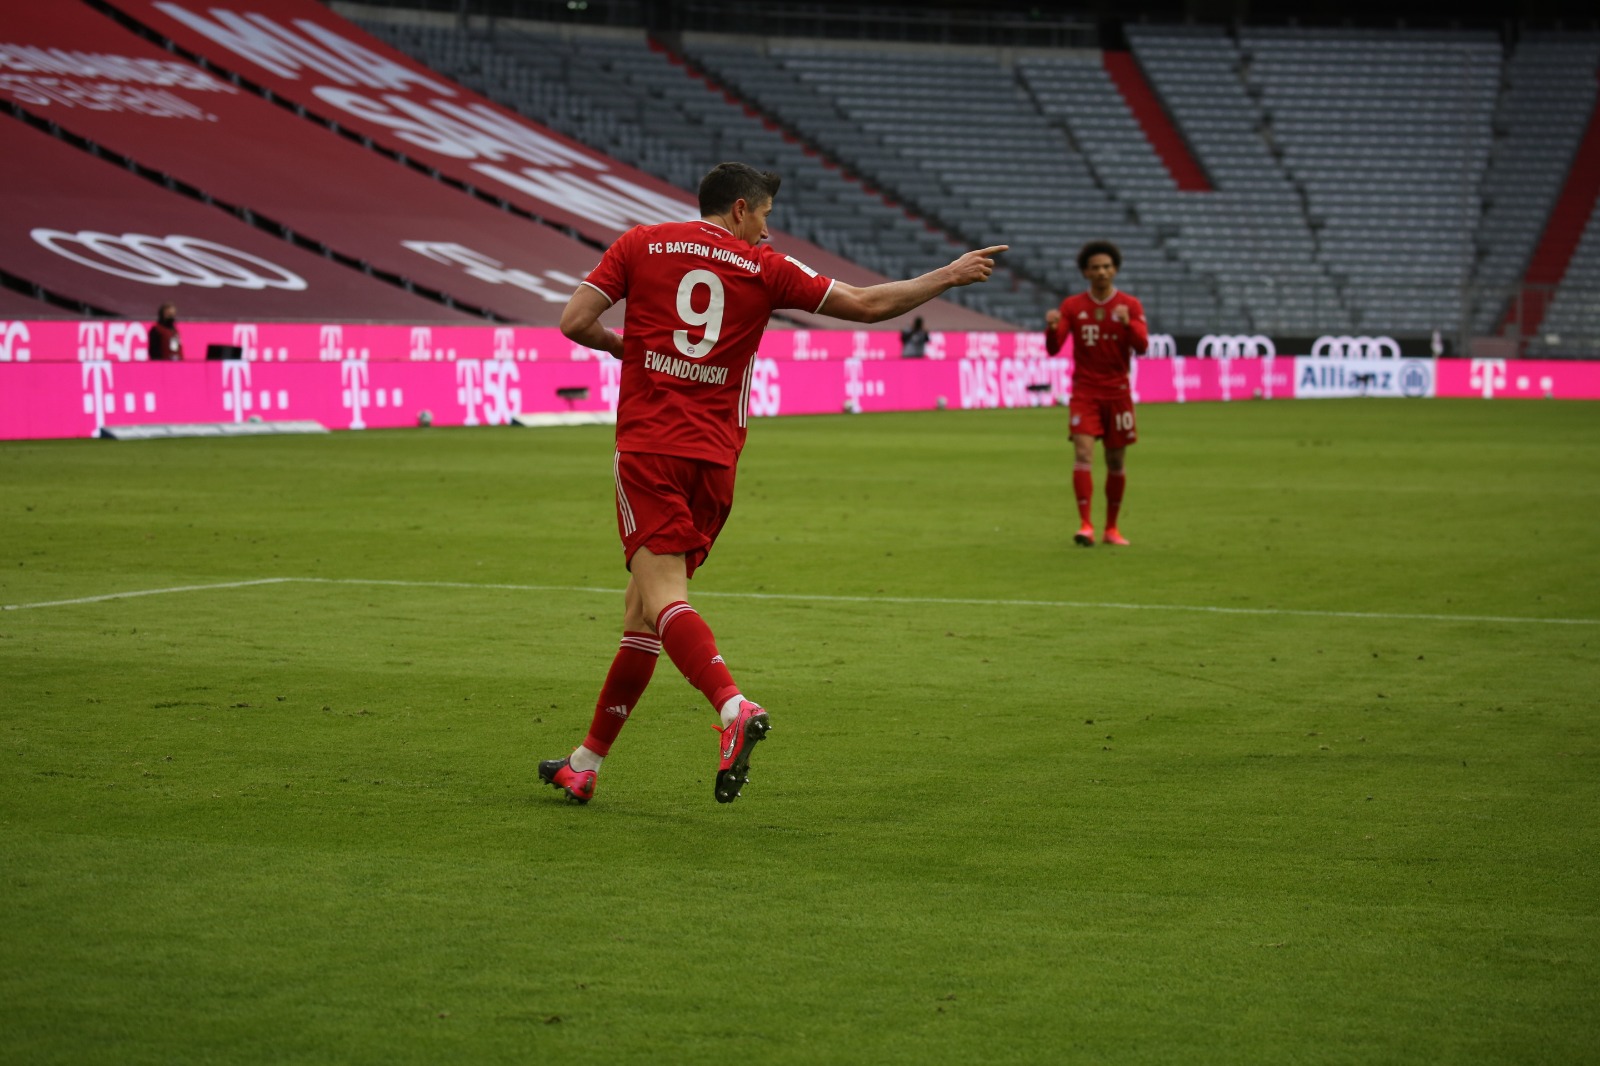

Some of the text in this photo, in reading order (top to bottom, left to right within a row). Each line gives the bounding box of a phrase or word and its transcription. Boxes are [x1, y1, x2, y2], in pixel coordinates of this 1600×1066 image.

[648, 242, 663, 255] FC
[665, 241, 710, 258] BAYERN
[672, 268, 725, 359] 9
[644, 350, 729, 385] EWANDOWSKI
[1301, 365, 1392, 391] Allianz
[1115, 411, 1134, 432] 10
